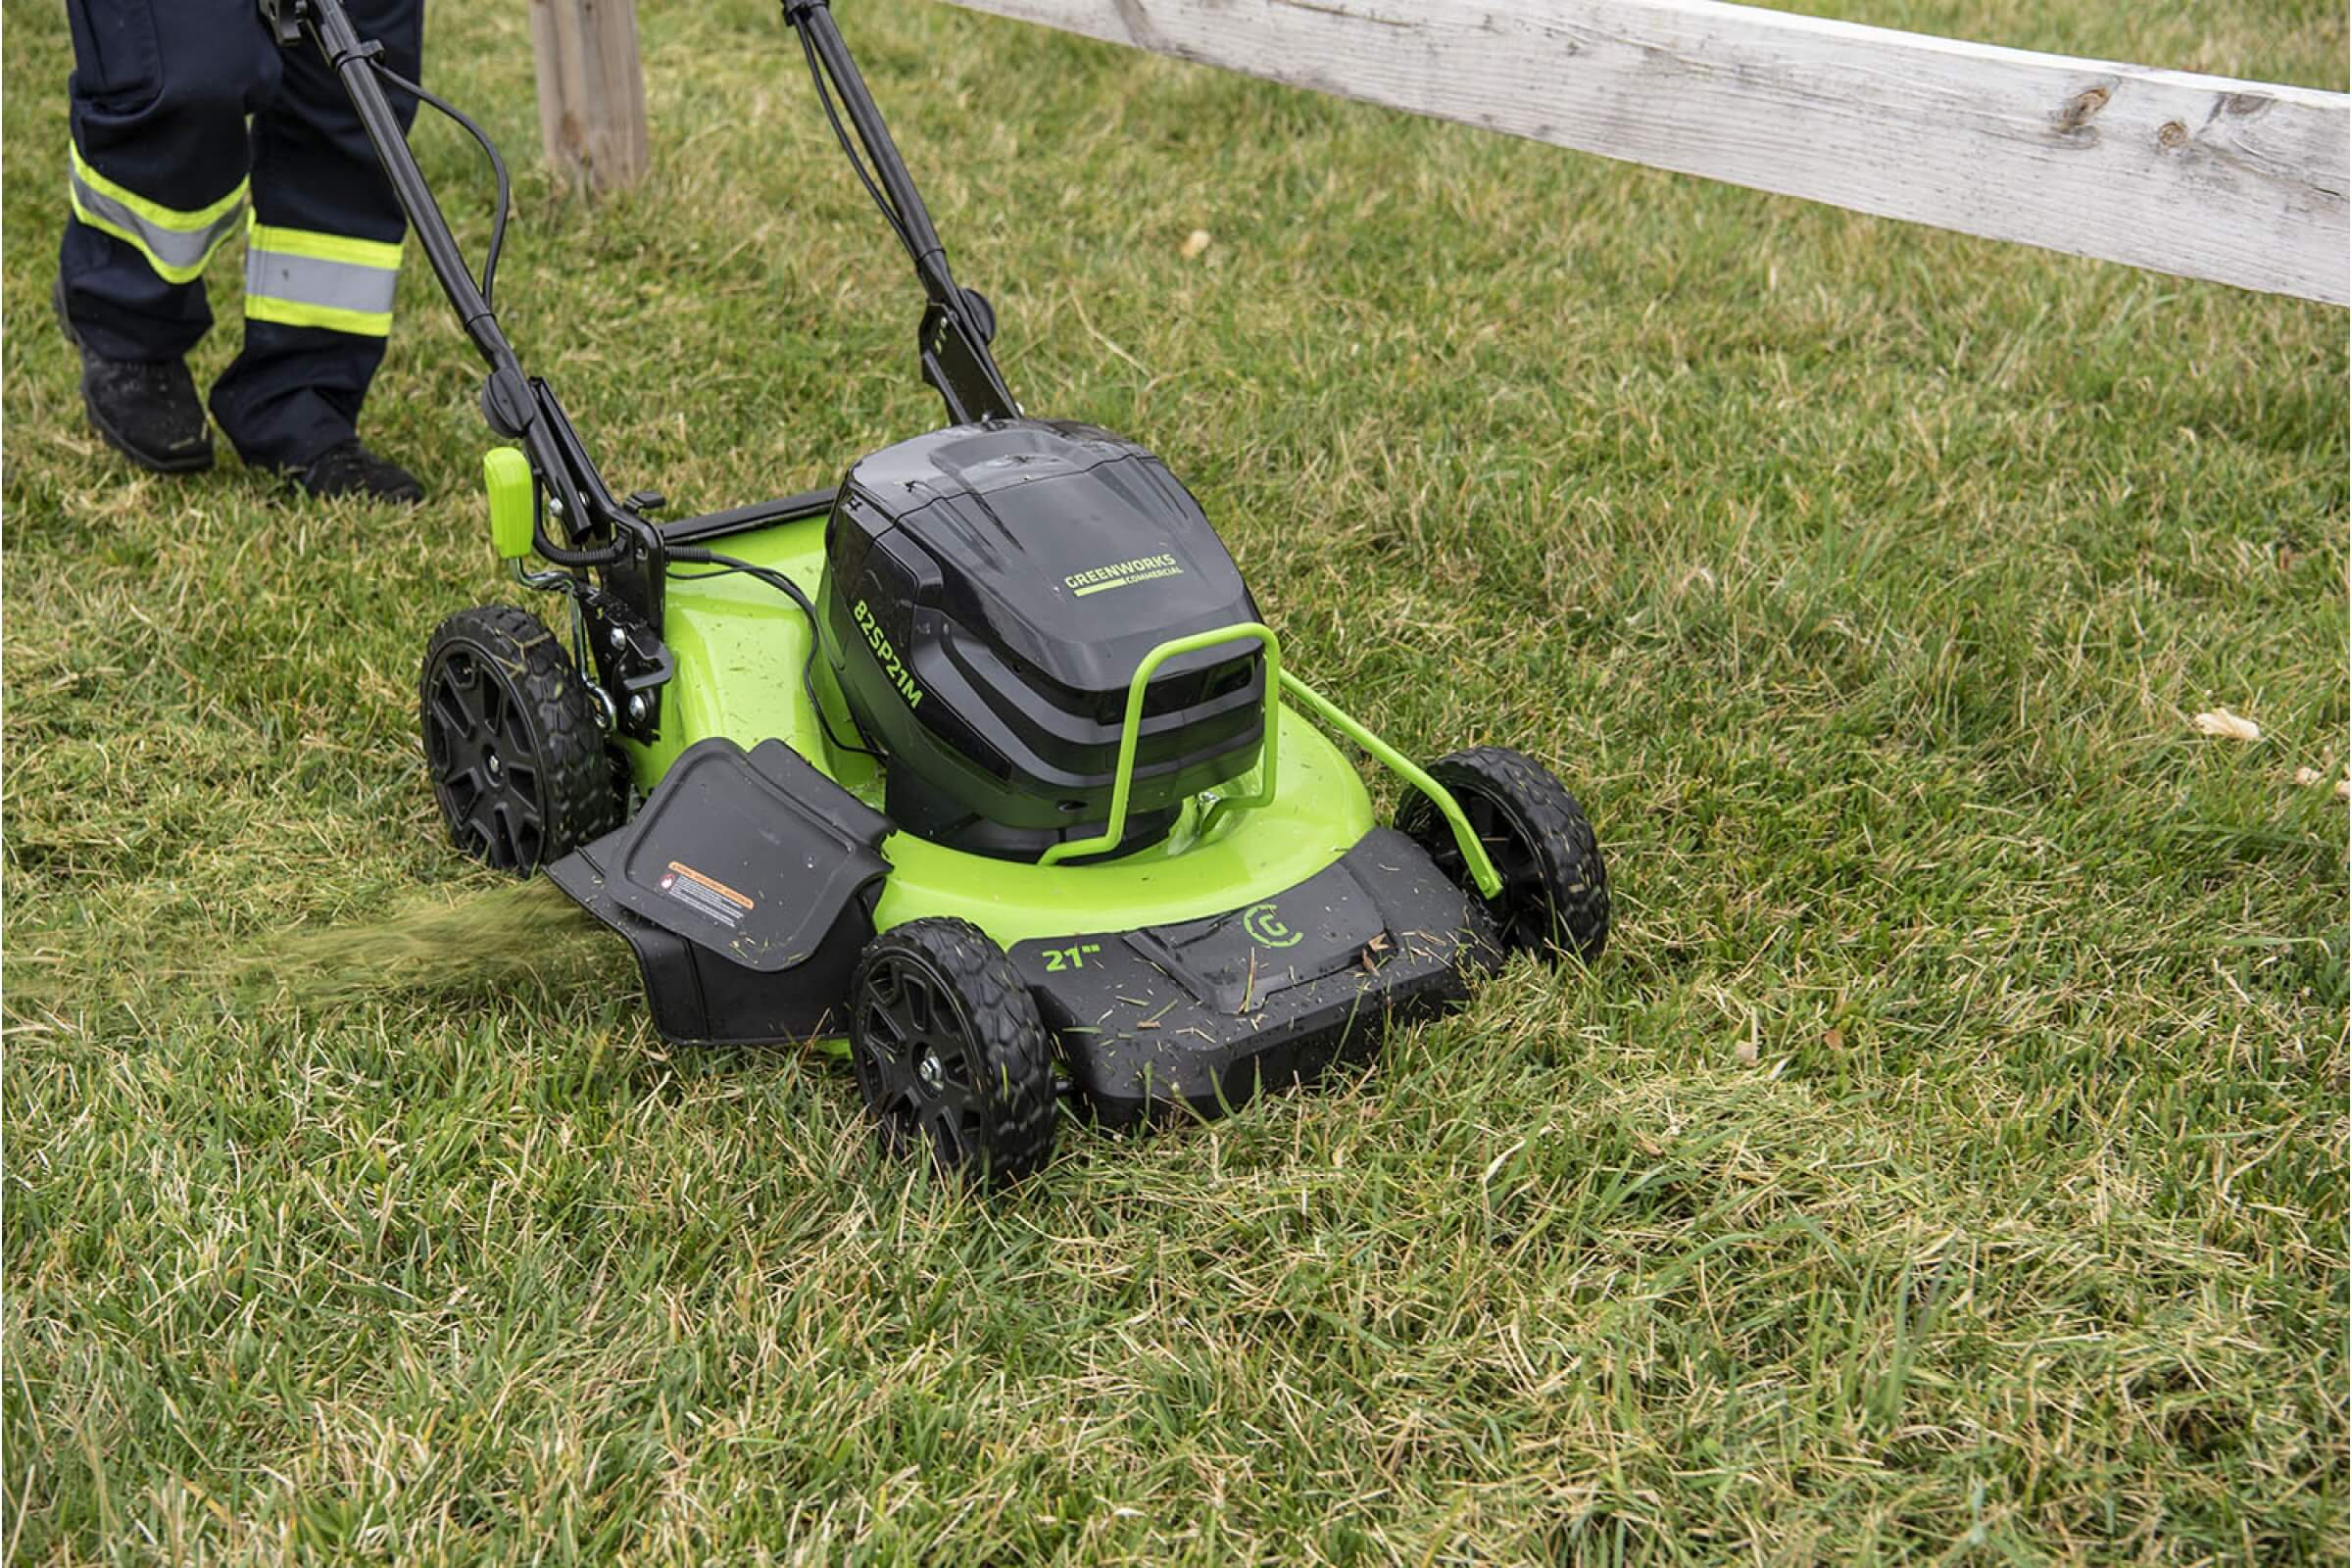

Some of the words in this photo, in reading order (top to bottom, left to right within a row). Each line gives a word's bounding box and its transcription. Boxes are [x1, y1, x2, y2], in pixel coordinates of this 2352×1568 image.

[1064, 553, 1177, 588] GREENWORKS
[1126, 565, 1184, 584] COMMERCIAL
[854, 599, 923, 709] 82SP21M
